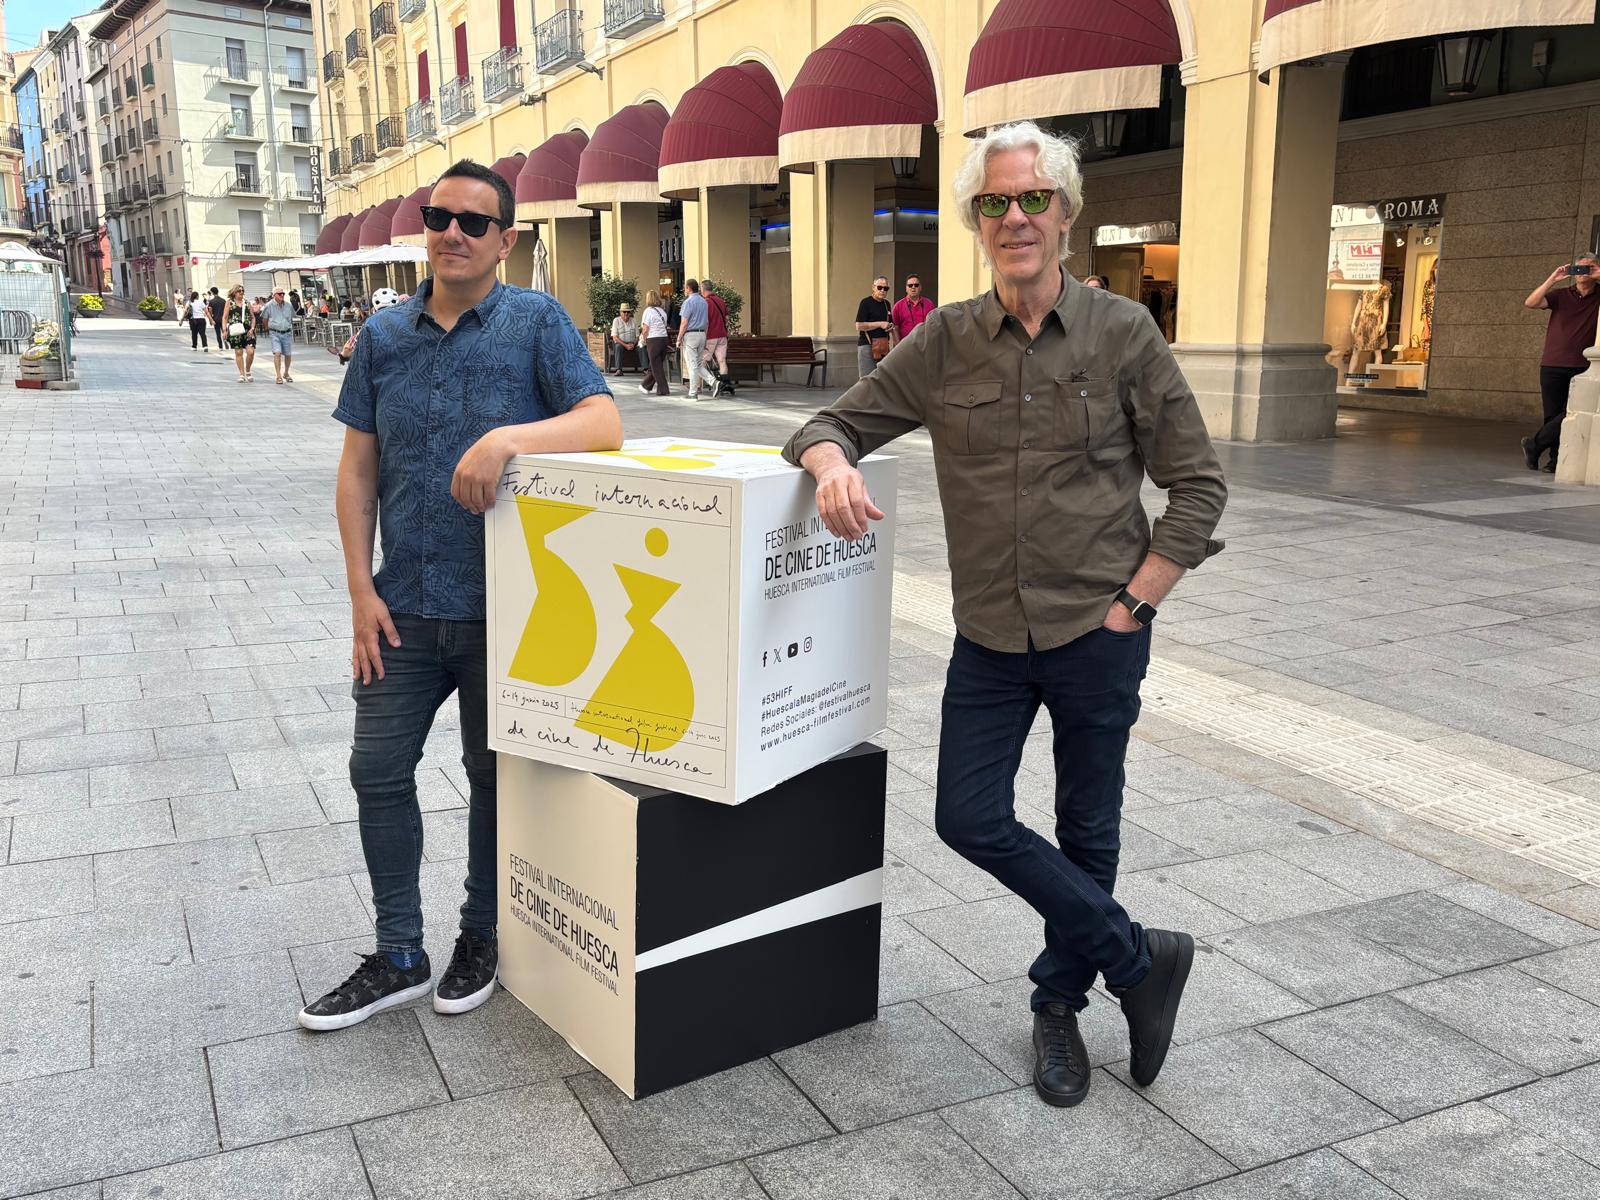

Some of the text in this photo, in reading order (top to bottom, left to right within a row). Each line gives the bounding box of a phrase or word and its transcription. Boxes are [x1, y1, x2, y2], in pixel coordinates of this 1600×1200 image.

[309, 147, 320, 203] HOSTAL
[1384, 198, 1439, 220] ROMA
[502, 471, 722, 515] Festival internacional
[765, 521, 809, 551] FESTIVAL
[765, 532, 877, 582] DE CINE DE HUESCA
[764, 559, 876, 601] HUESCA INTERNATIONAL FILM FESTIVAL
[502, 689, 518, 702] 6-14
[542, 699, 560, 710] 2025
[761, 685, 793, 706] #53HIFF
[761, 680, 847, 722] #HuescalaMagiadelCine
[761, 720, 784, 737] Redes
[818, 683, 871, 711] @festivalhuesca
[507, 720, 712, 775] de cine de Huesca
[760, 696, 871, 752] www.huesca-filmfestival.com
[510, 853, 619, 931] FESTIVAL INTERNACIONAL
[510, 904, 619, 996] HUESCA INTERNATIONAL FILM FESTIVAL
[511, 875, 619, 977] DE CINE DE HUESCA
